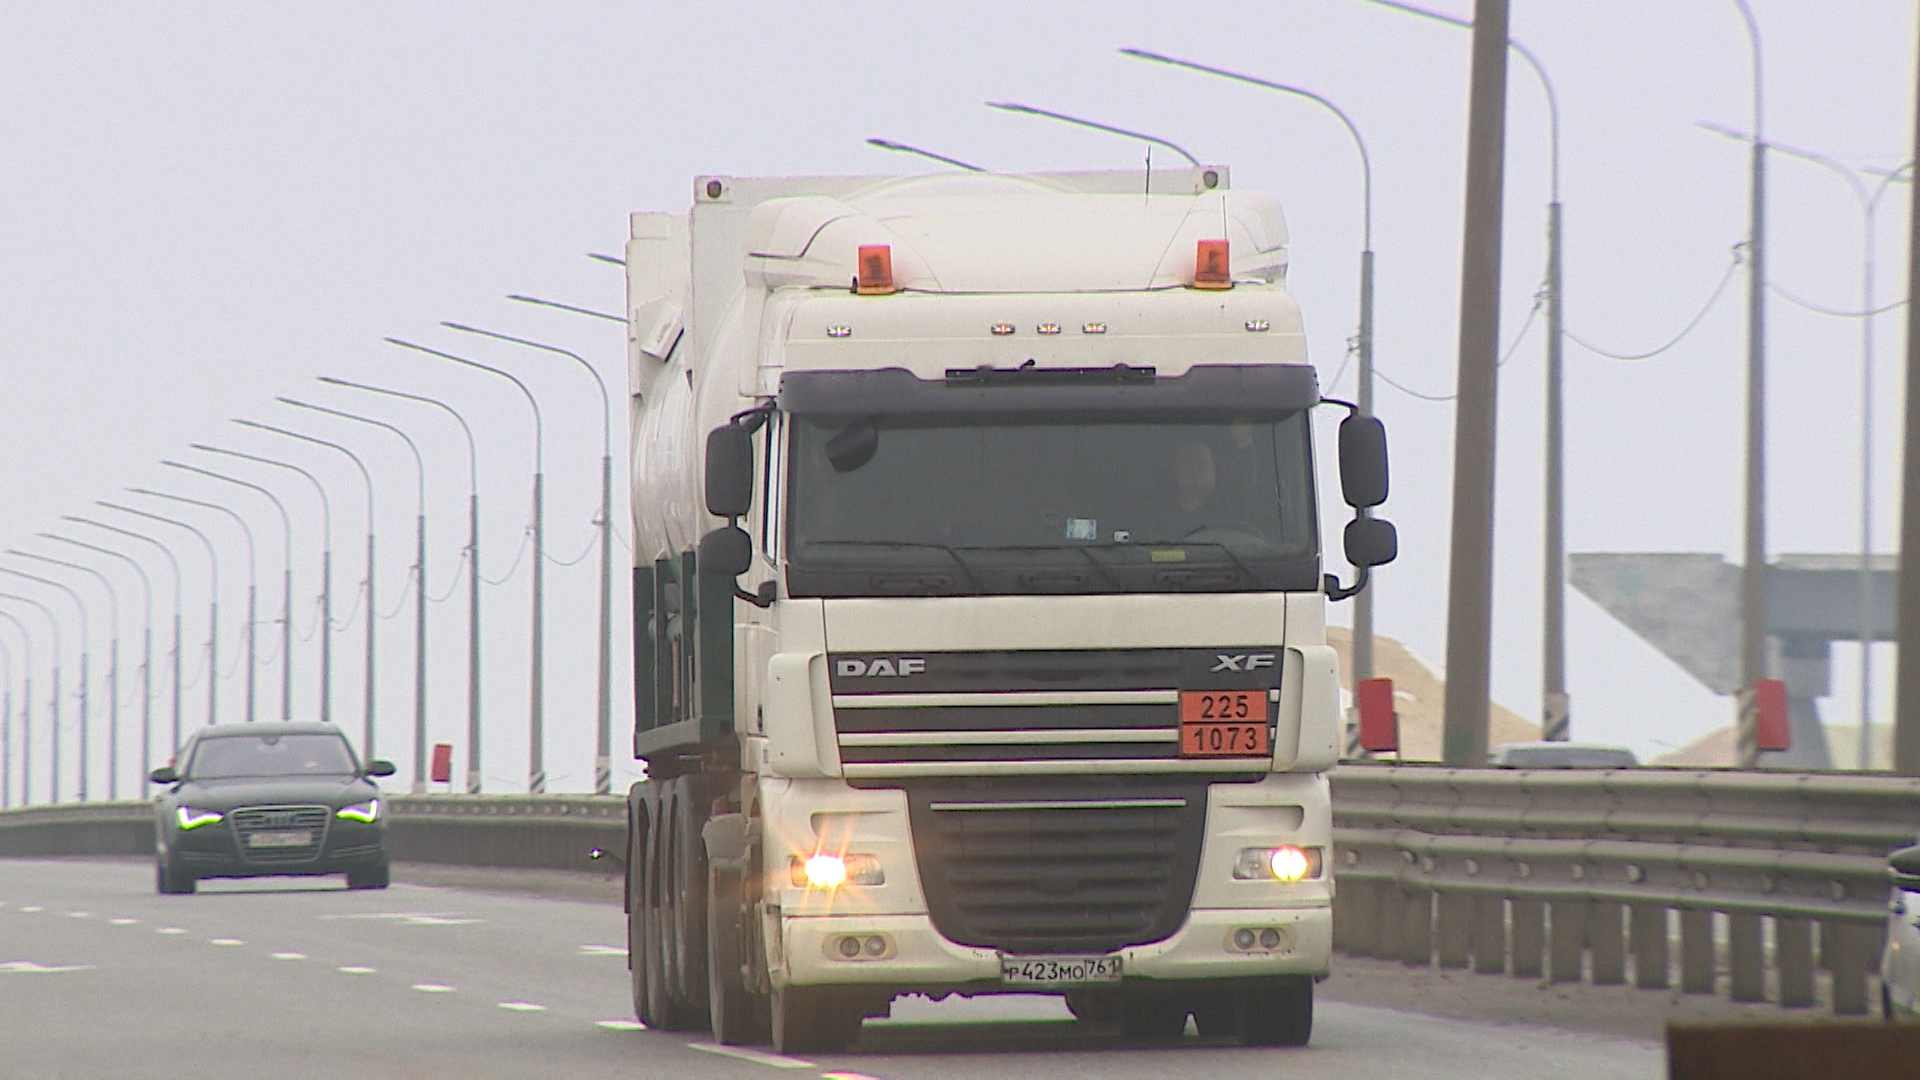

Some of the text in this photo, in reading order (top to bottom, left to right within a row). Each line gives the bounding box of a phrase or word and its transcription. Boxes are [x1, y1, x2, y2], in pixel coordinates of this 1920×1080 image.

[837, 658, 926, 677] DAF
[1210, 654, 1276, 672] XF
[1201, 695, 1249, 718] 225
[1194, 727, 1257, 751] 1073
